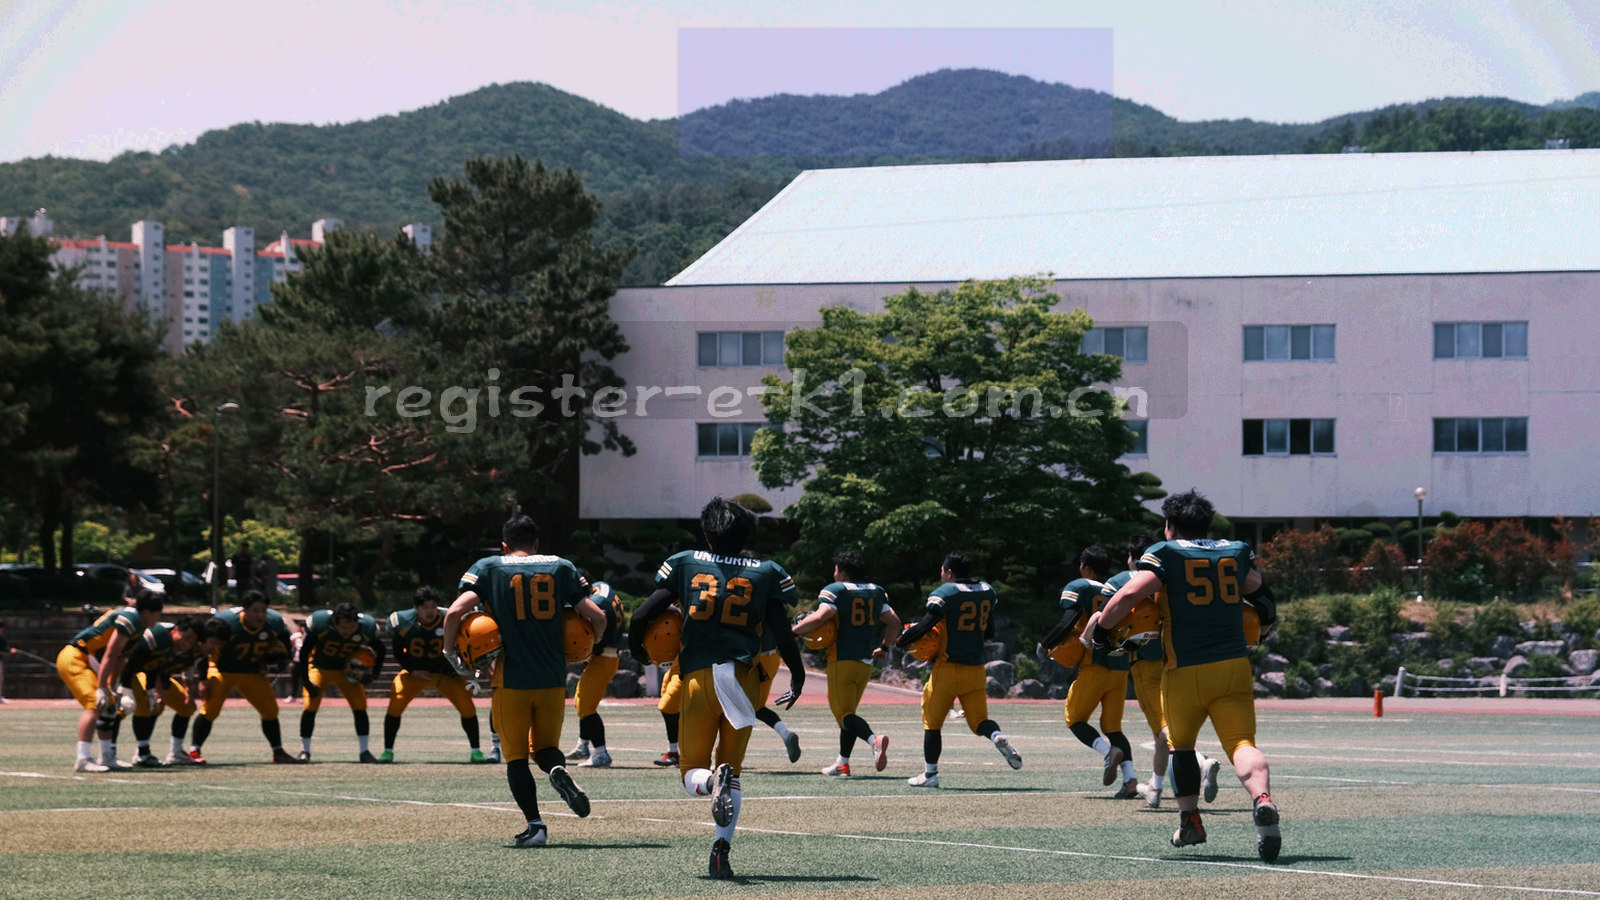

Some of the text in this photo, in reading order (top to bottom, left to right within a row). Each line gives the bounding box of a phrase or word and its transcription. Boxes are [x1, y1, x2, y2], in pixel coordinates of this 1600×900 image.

[510, 574, 556, 620] 18
[689, 573, 753, 626] 32
[1185, 558, 1240, 605] 56
[851, 598, 876, 626] 61
[957, 600, 992, 631] 28
[410, 637, 443, 658] 63
